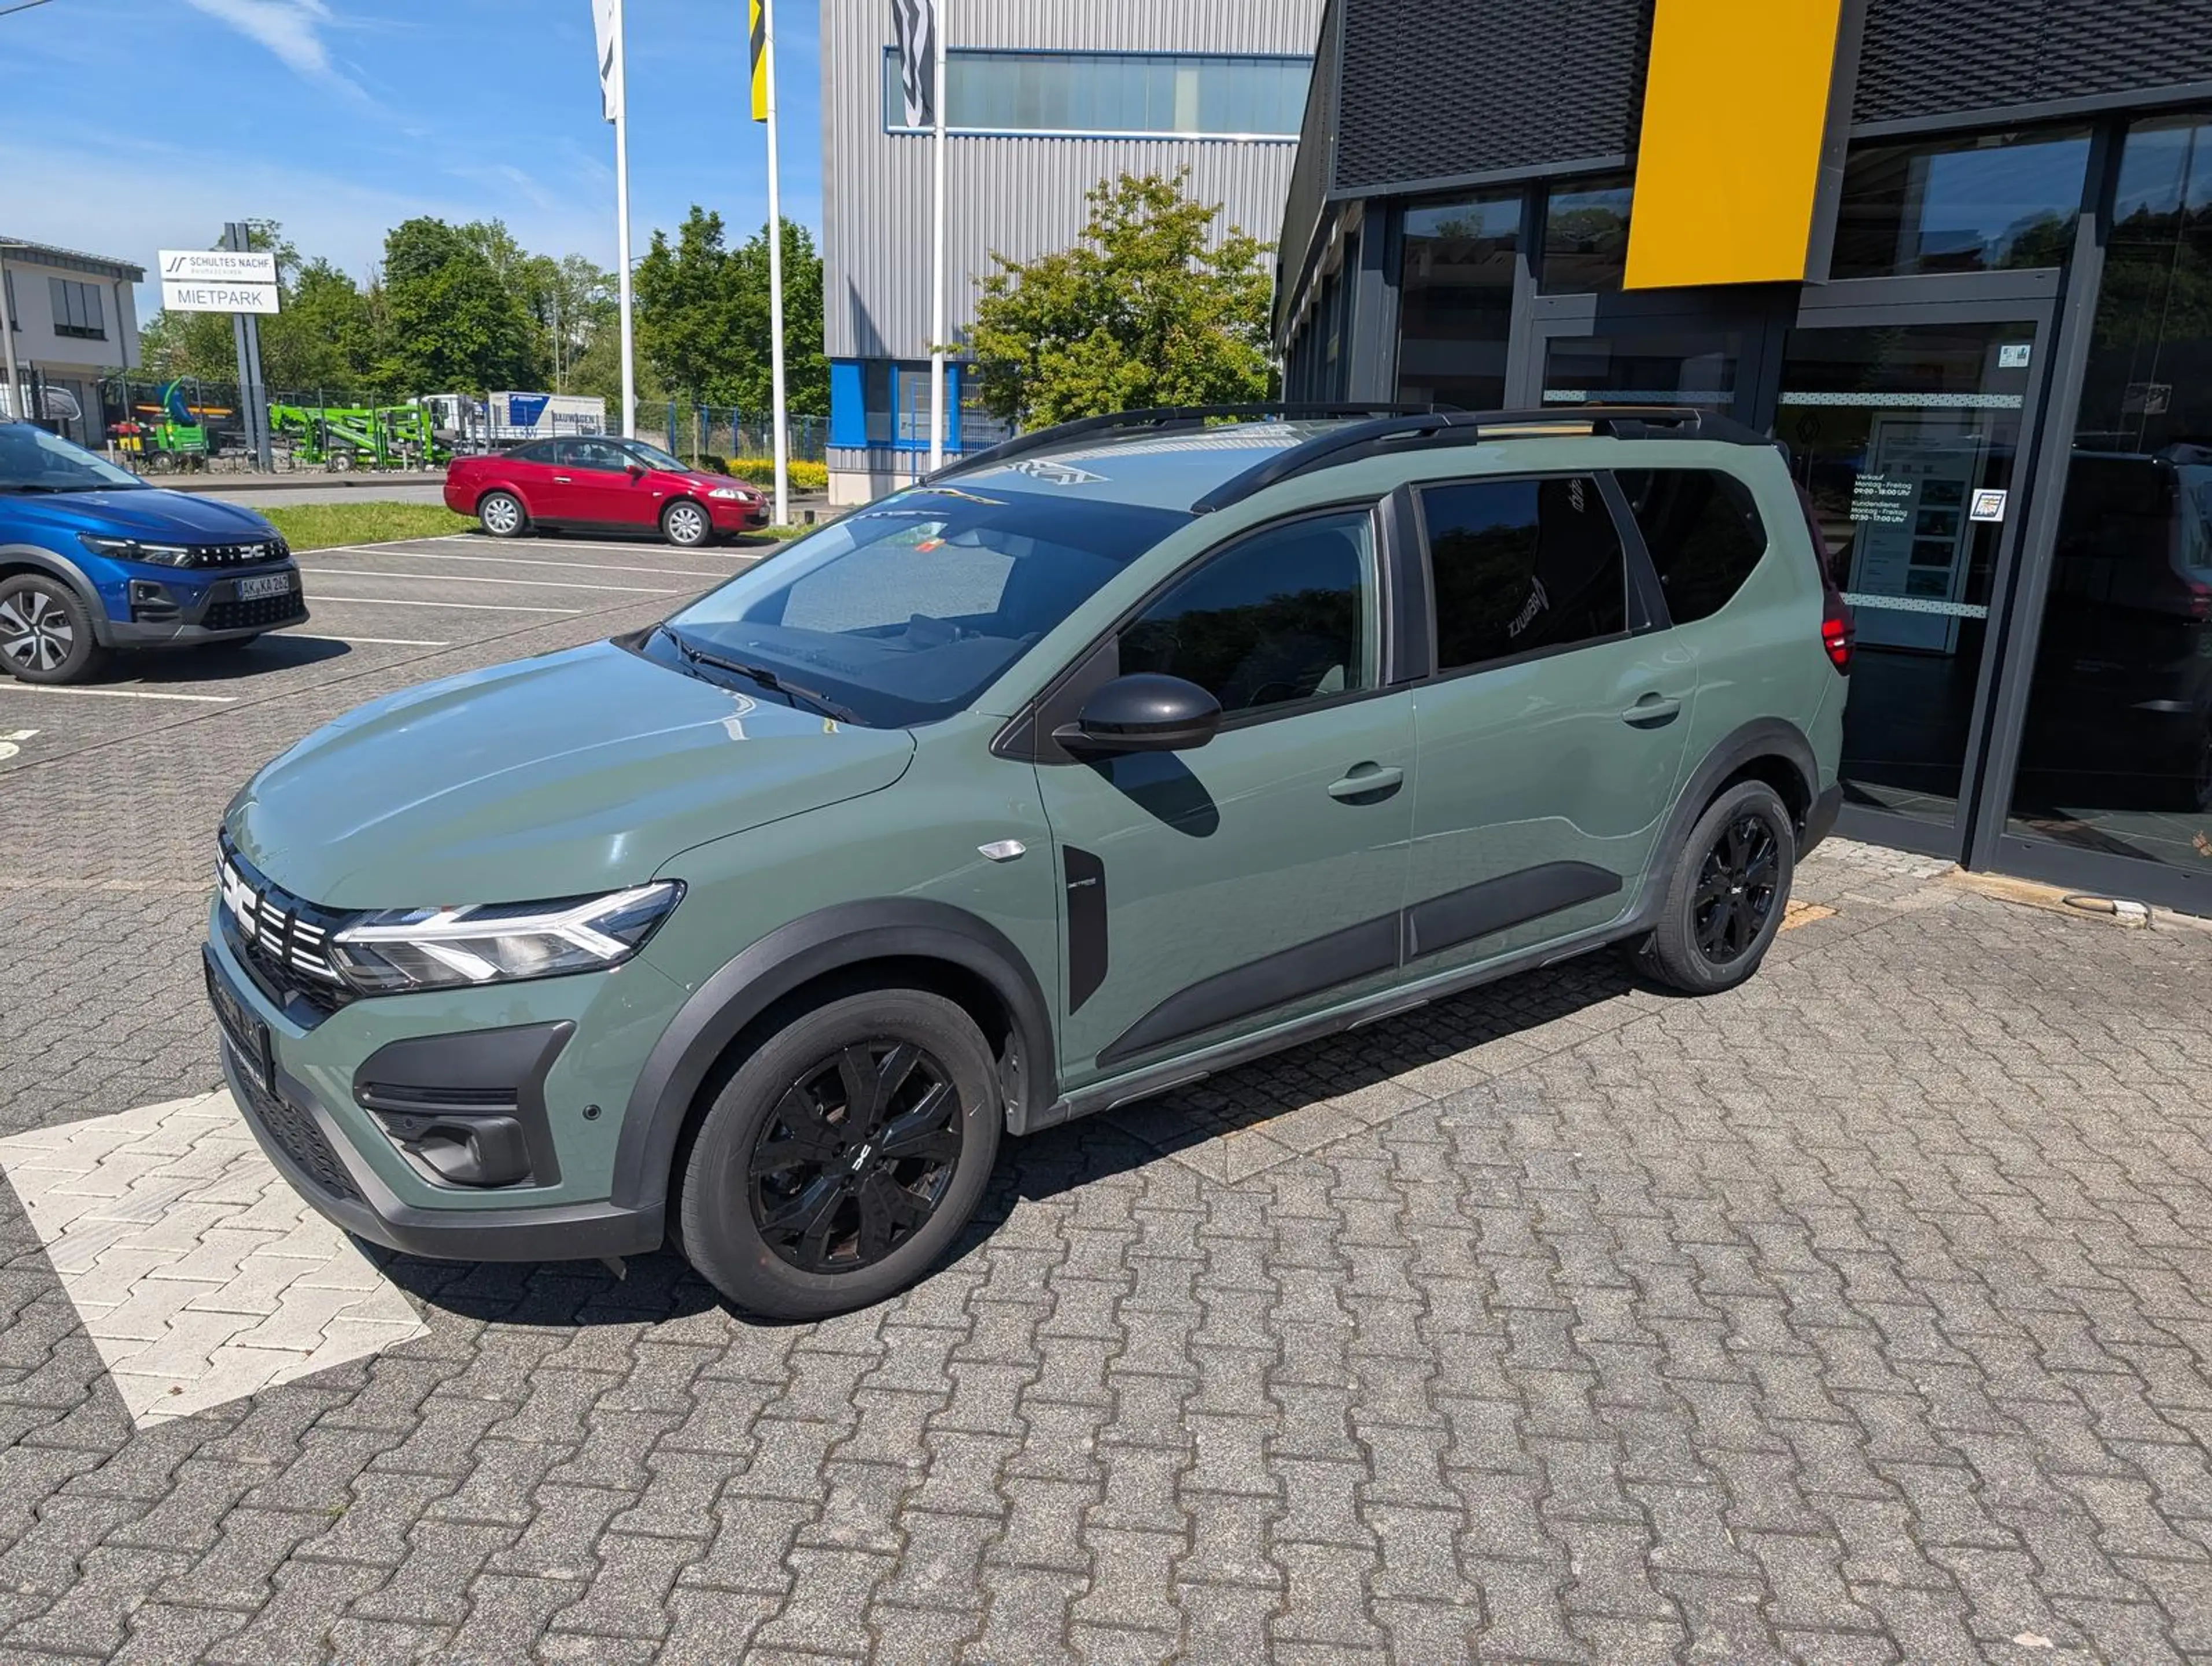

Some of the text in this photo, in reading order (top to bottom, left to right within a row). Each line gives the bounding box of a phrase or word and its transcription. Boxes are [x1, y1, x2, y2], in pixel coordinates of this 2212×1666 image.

[190, 257, 236, 267] SCHULTES
[178, 290, 263, 305] MIETPARK
[1855, 481, 1882, 489] Montag
[1886, 481, 1912, 491] Freitag
[1851, 500, 1900, 508] Kundendienst
[1850, 507, 1878, 515] Montag
[1882, 508, 1908, 518] Freitag
